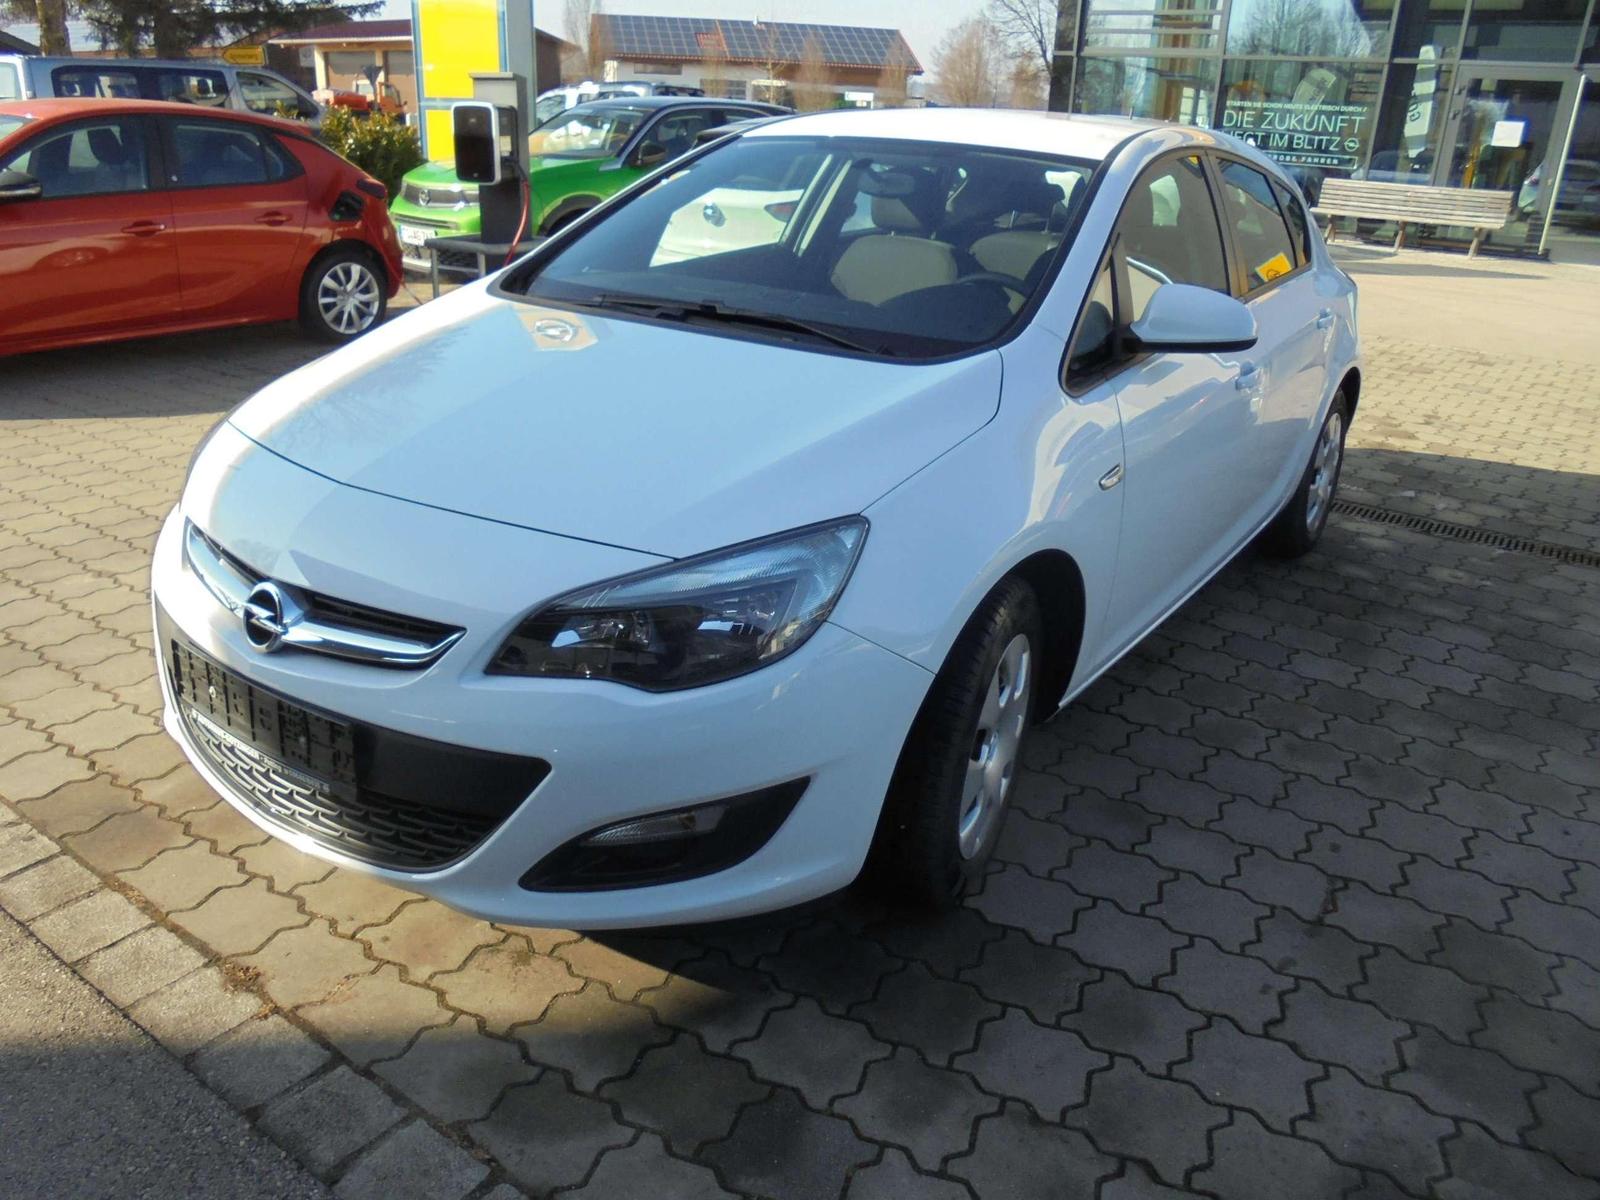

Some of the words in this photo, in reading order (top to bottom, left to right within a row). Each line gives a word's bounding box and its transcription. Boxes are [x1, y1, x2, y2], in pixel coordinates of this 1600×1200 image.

[1222, 109, 1256, 128] DIE
[1260, 111, 1366, 134] ZUKUNFT
[1268, 133, 1289, 148] IM
[1292, 134, 1341, 151] BLITZ
